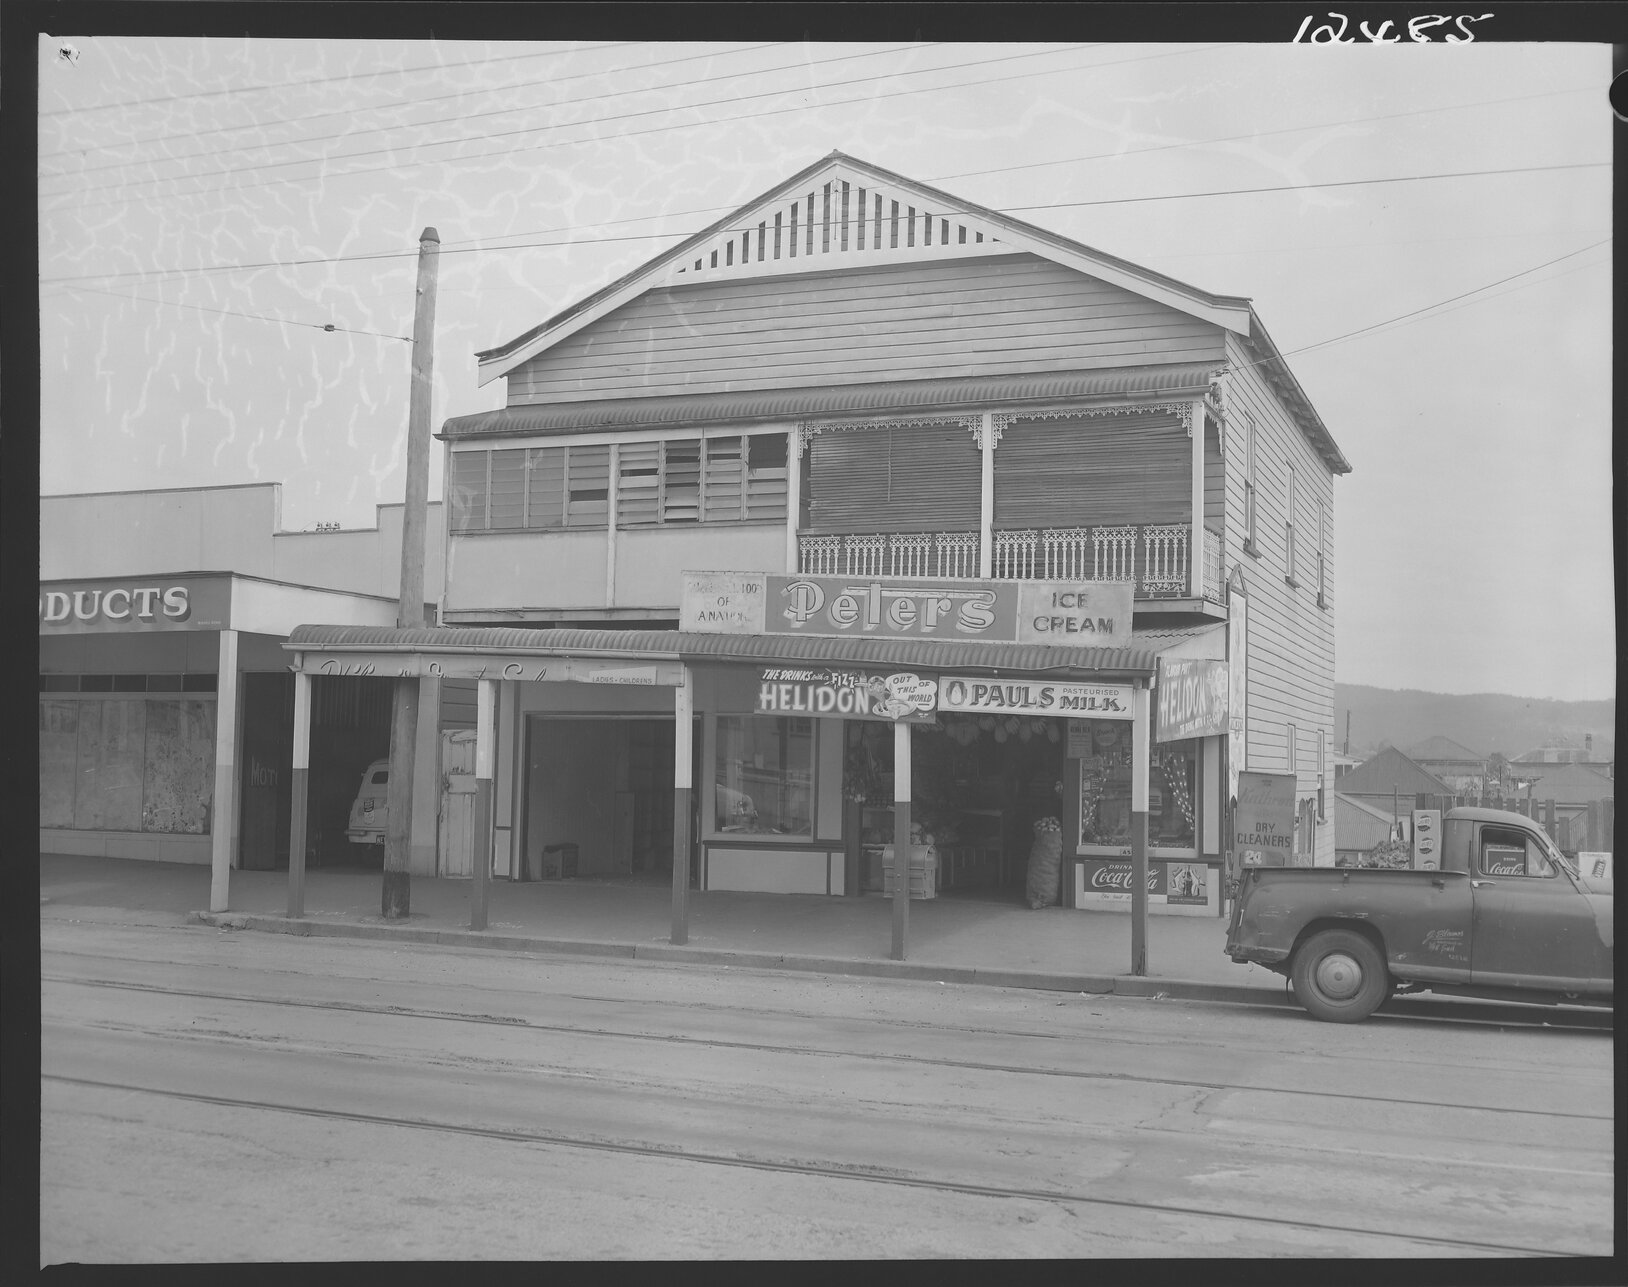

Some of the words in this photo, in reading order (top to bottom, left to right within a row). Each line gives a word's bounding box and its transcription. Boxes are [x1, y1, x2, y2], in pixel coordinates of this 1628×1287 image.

[39, 586, 189, 622] DUCTS
[781, 581, 997, 633] Peters
[1052, 591, 1089, 608] ICE
[1033, 615, 1114, 634] CREAM
[762, 669, 780, 680] THE
[780, 669, 813, 681] DRINKS
[831, 672, 855, 688] FIZZ
[892, 676, 912, 685] OUT
[760, 684, 869, 715] HELIDON
[970, 684, 1055, 708] PAULS
[1062, 688, 1120, 696] PASTEURISED
[1161, 676, 1206, 728] HELIDON
[1256, 822, 1276, 833] DRY
[1238, 833, 1291, 848] CLEANERS
